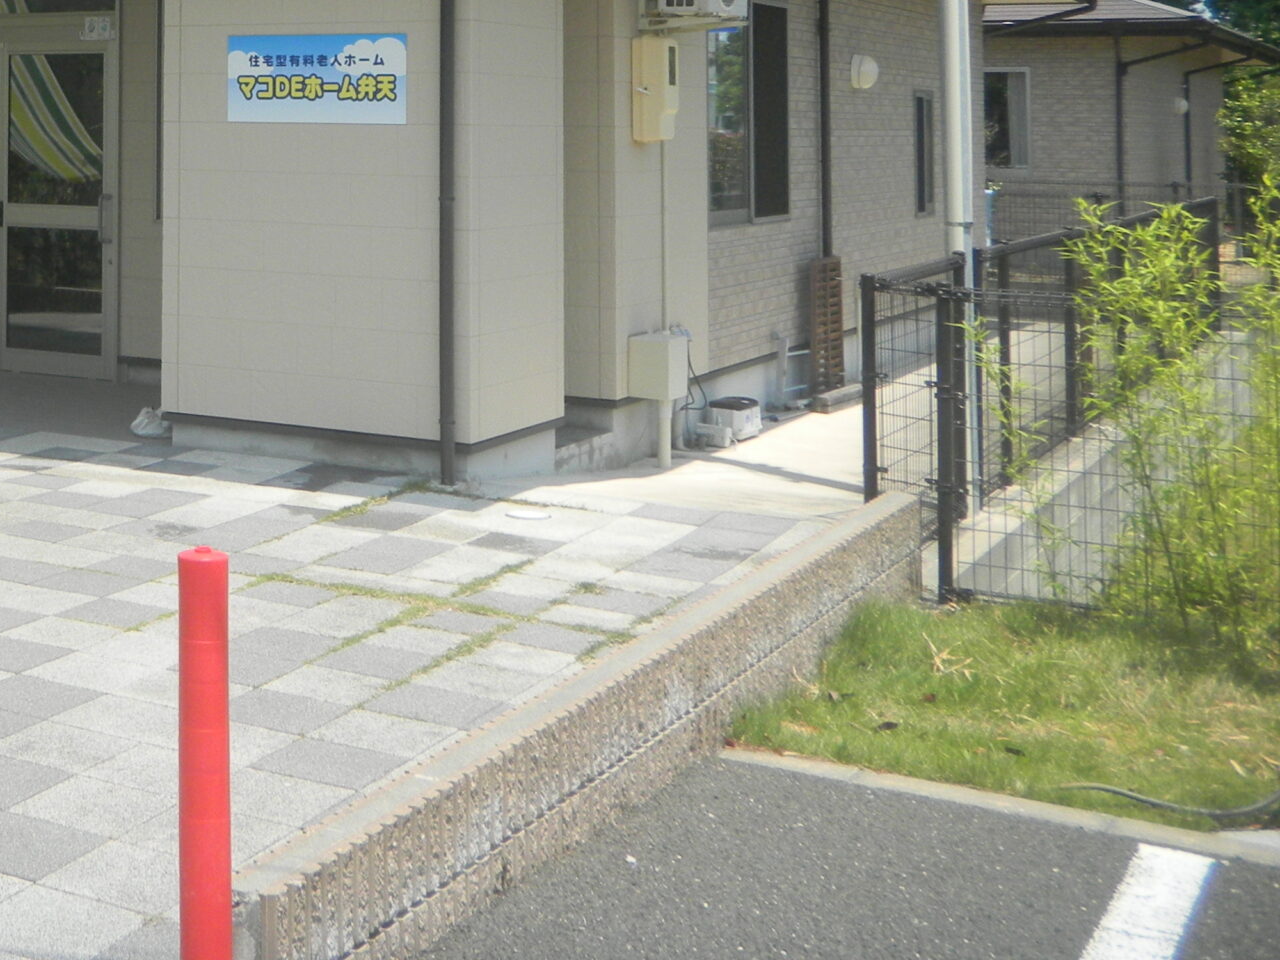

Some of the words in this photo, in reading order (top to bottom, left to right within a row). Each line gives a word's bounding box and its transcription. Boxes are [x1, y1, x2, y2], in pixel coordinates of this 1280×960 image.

[249, 54, 385, 67] 住宅型有料老人ホーム
[237, 73, 396, 101] マコDEホーム弁天
